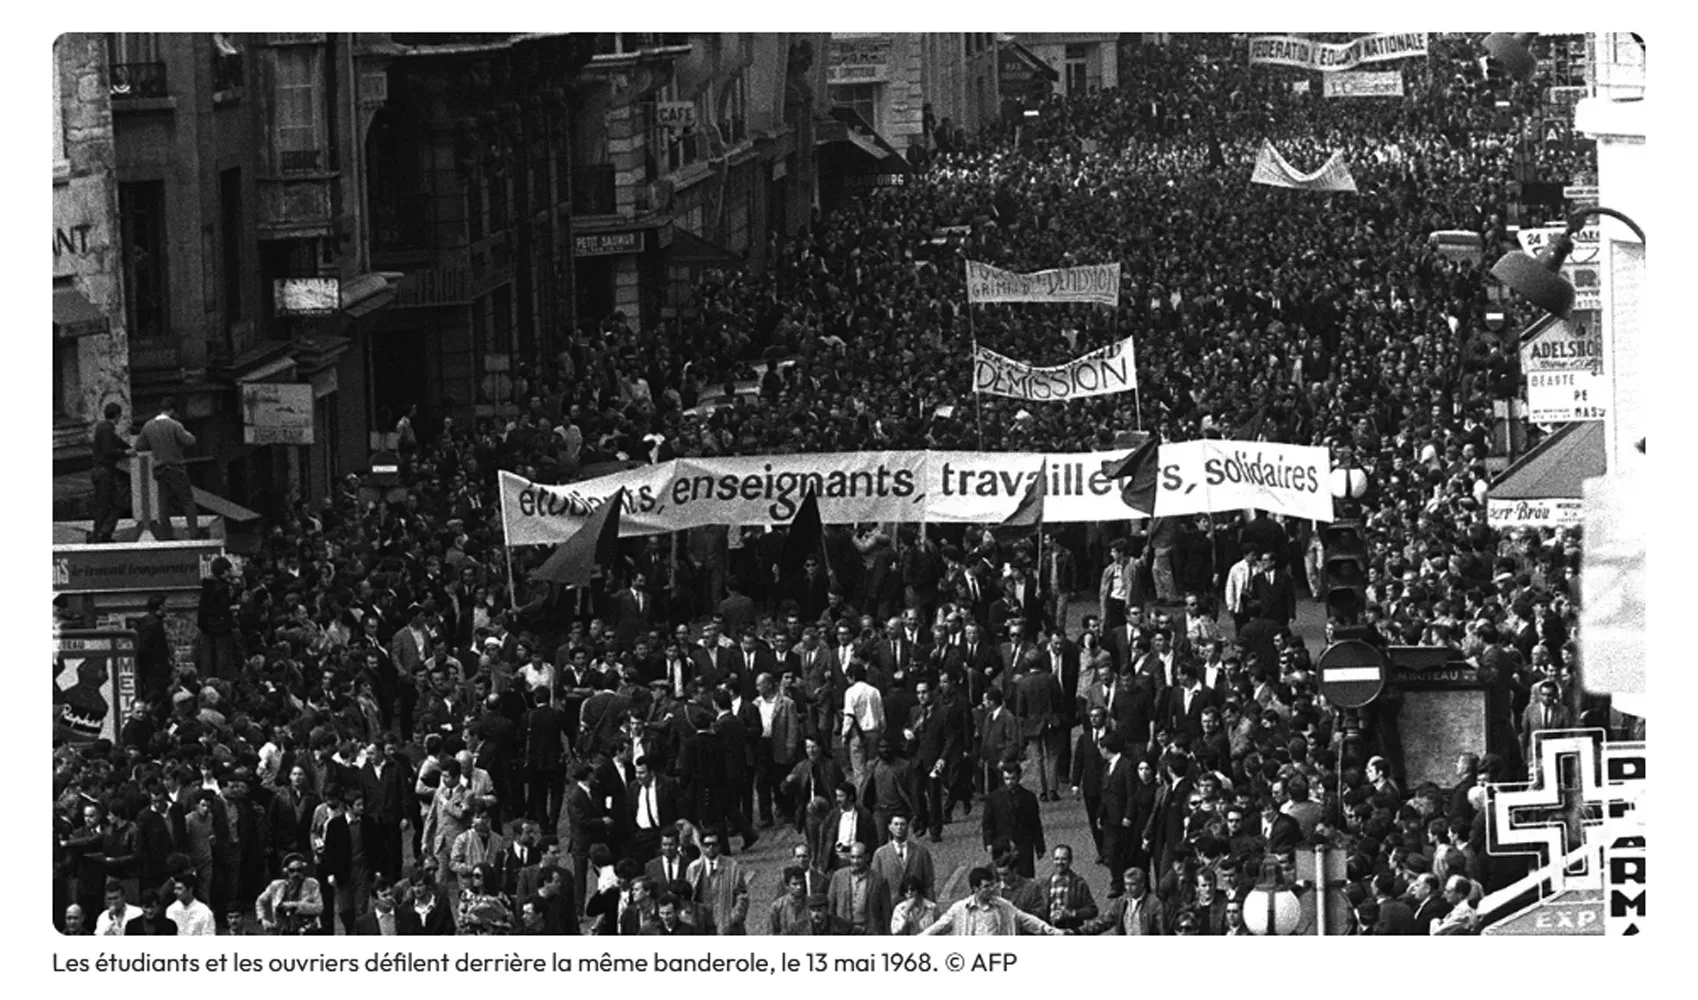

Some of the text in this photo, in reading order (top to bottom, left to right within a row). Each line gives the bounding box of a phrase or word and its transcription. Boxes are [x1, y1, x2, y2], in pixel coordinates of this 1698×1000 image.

[52, 225, 91, 257] NT
[672, 463, 926, 520] enseignants,
[941, 461, 1197, 497] travailles,
[1206, 451, 1319, 494] solidaires
